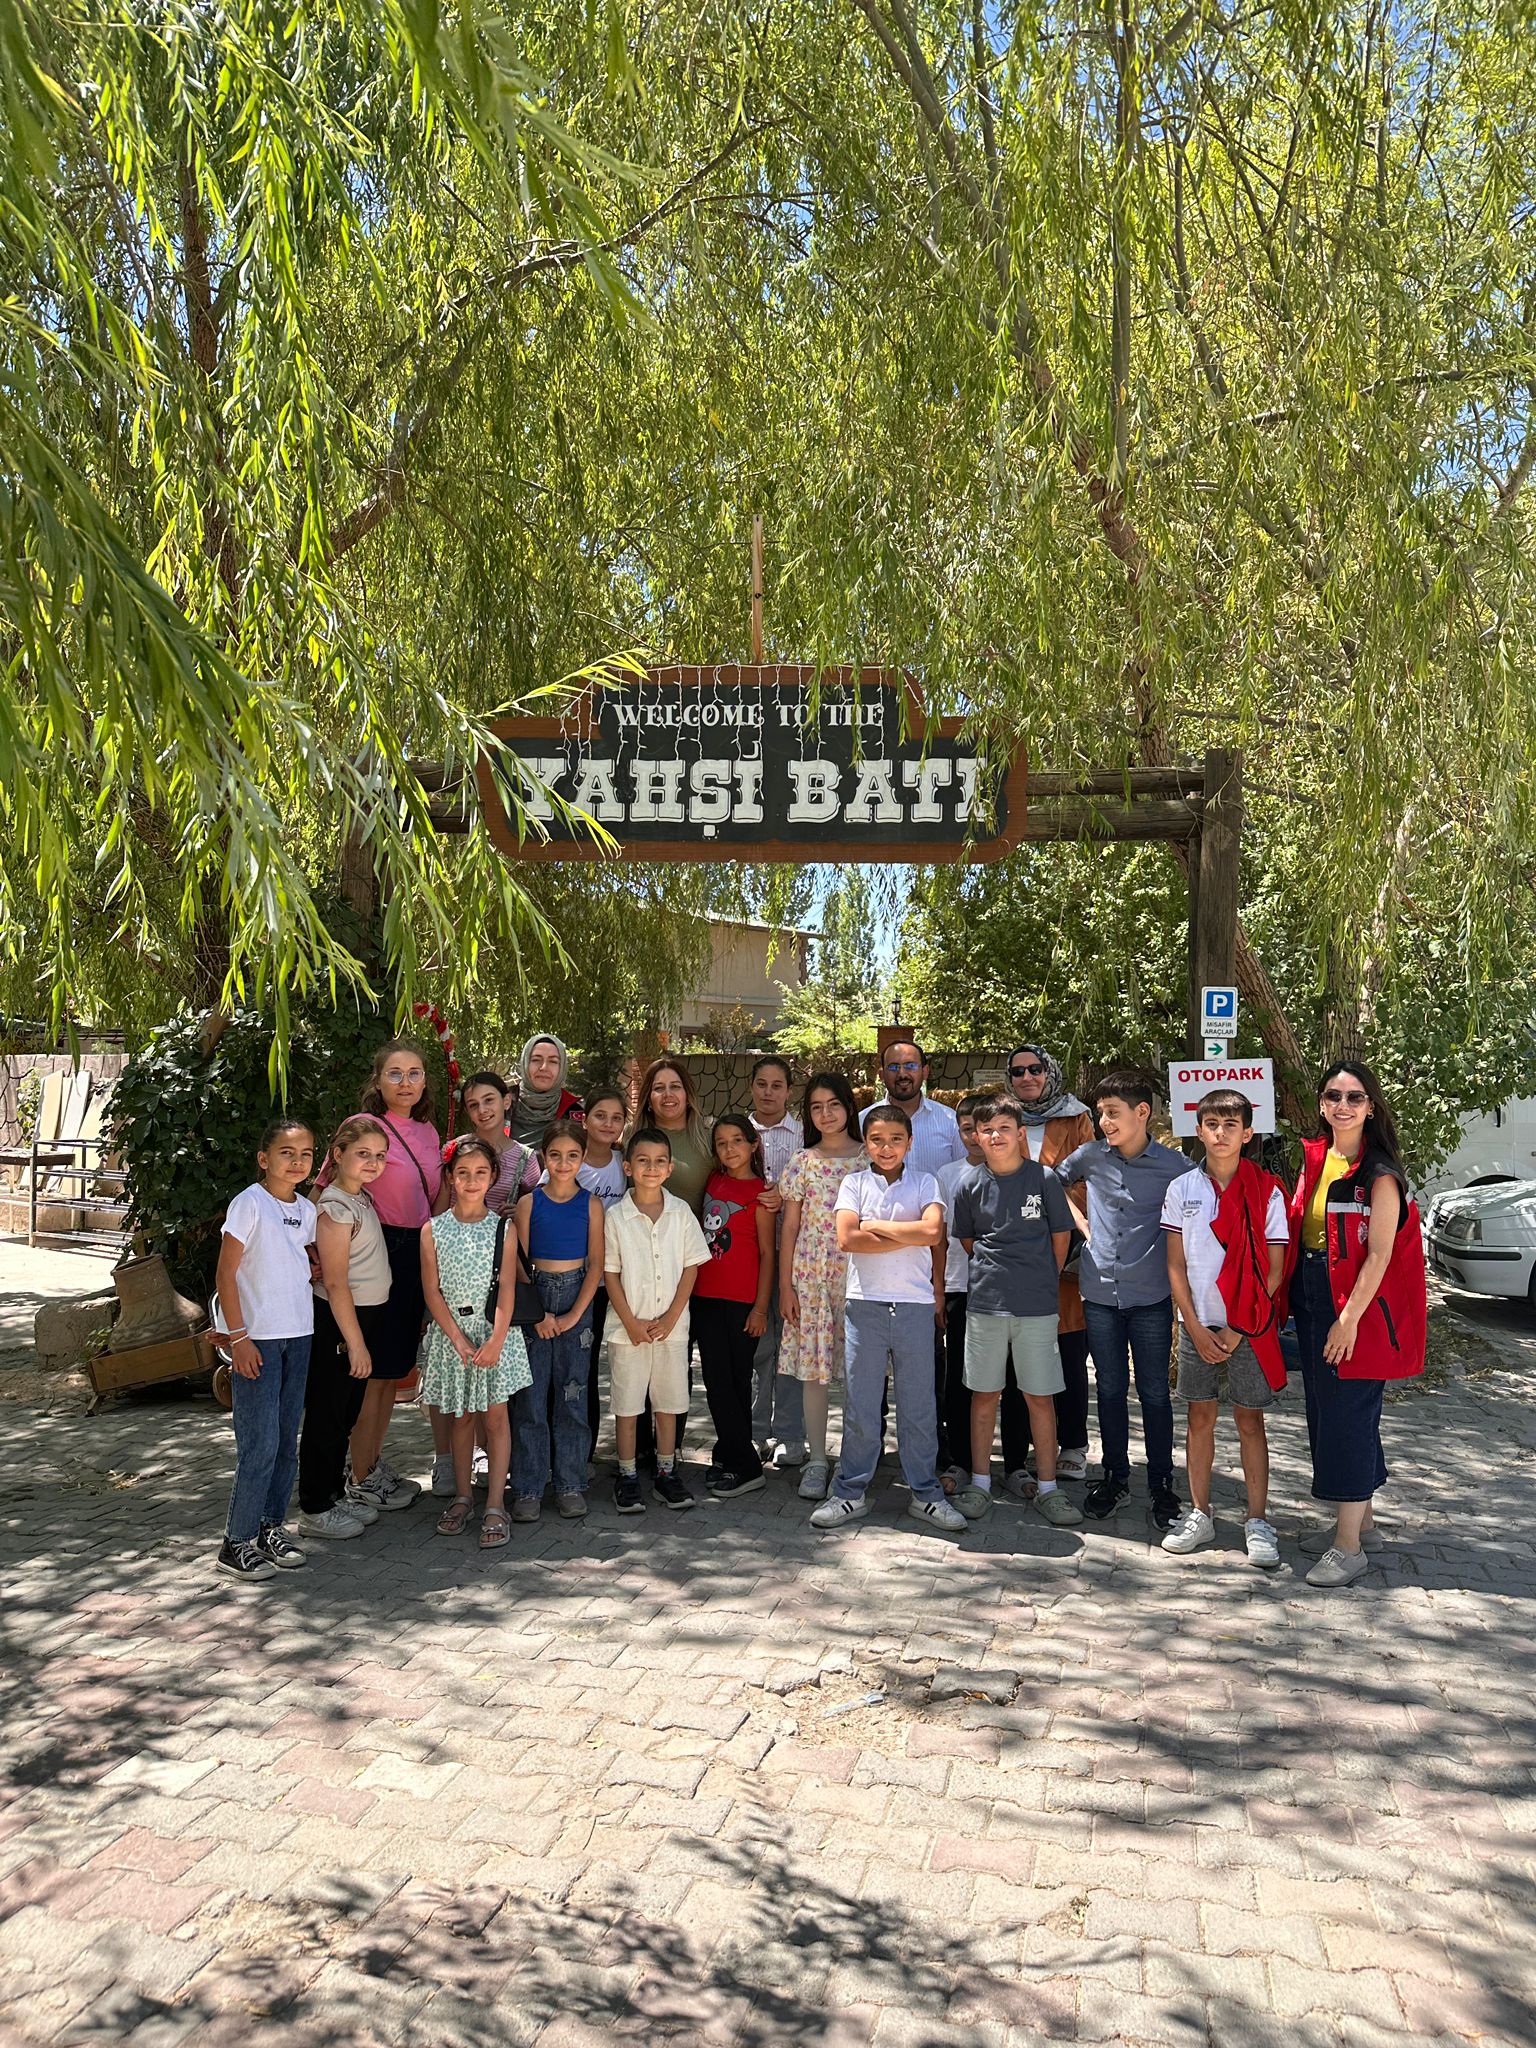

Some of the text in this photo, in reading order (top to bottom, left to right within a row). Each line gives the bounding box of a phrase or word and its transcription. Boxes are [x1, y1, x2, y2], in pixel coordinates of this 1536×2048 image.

[612, 704, 884, 727] WELCOME TO THE
[787, 757, 988, 823] BATI
[1212, 994, 1228, 1014] P
[1204, 1028, 1234, 1036] ARAÇLAR
[1178, 1067, 1264, 1082] OTOPARK
